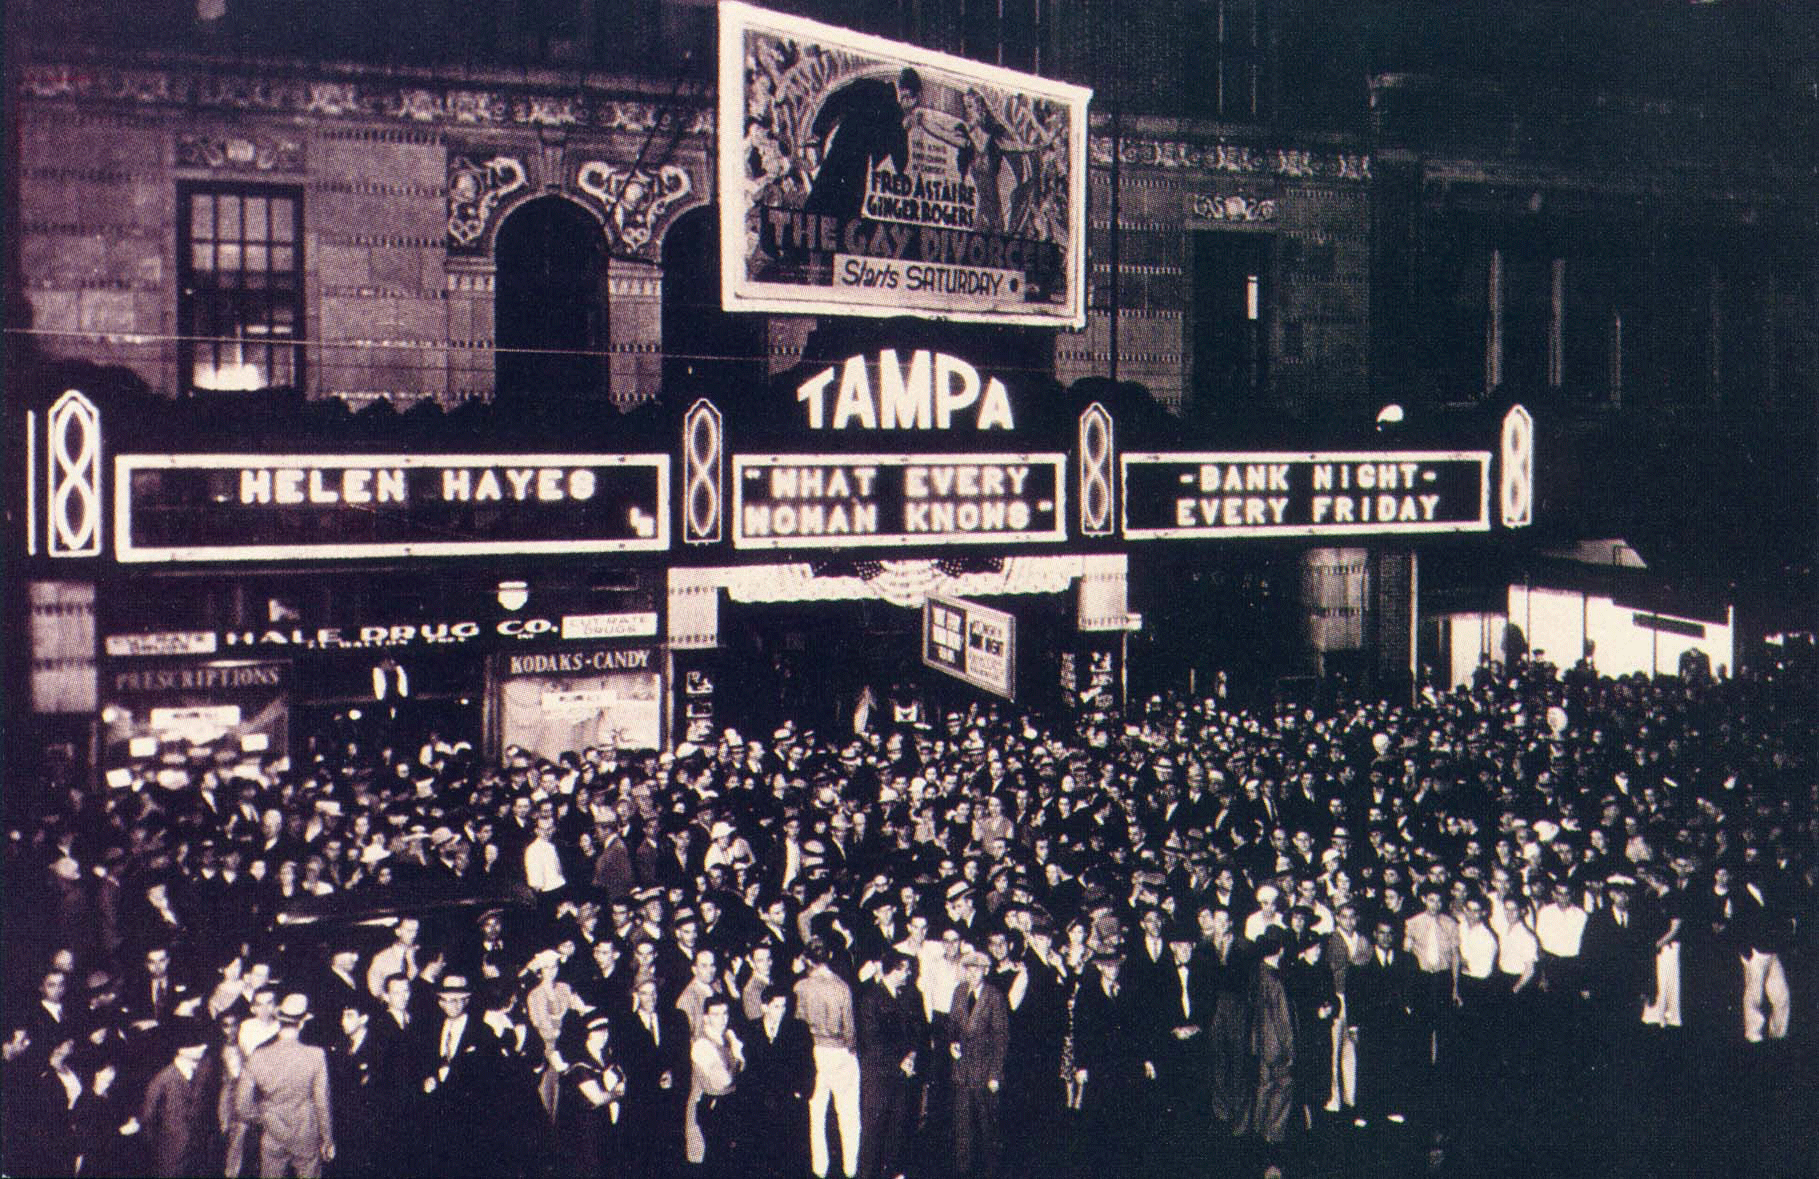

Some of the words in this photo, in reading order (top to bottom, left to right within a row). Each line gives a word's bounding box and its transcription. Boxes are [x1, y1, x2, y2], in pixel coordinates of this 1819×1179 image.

[871, 170, 912, 197] FRED
[913, 172, 977, 206] ASTAIRE
[867, 195, 920, 221] GINGER
[920, 201, 975, 228] ROGERS
[768, 209, 839, 251] THE
[844, 218, 912, 259] GAY
[841, 255, 902, 289] Starts
[905, 262, 1005, 296] SATURDAY
[795, 348, 1015, 431] TAMPA
[239, 469, 406, 504] HELEN
[441, 468, 597, 502] HAYES
[904, 464, 1030, 499] EVERY
[744, 504, 878, 537] WOMAN
[1177, 497, 1289, 527] EVERY
[1312, 494, 1440, 523] FRIDAY
[226, 628, 342, 645] HALE
[360, 622, 480, 642] DRUG
[496, 618, 559, 637] CO.
